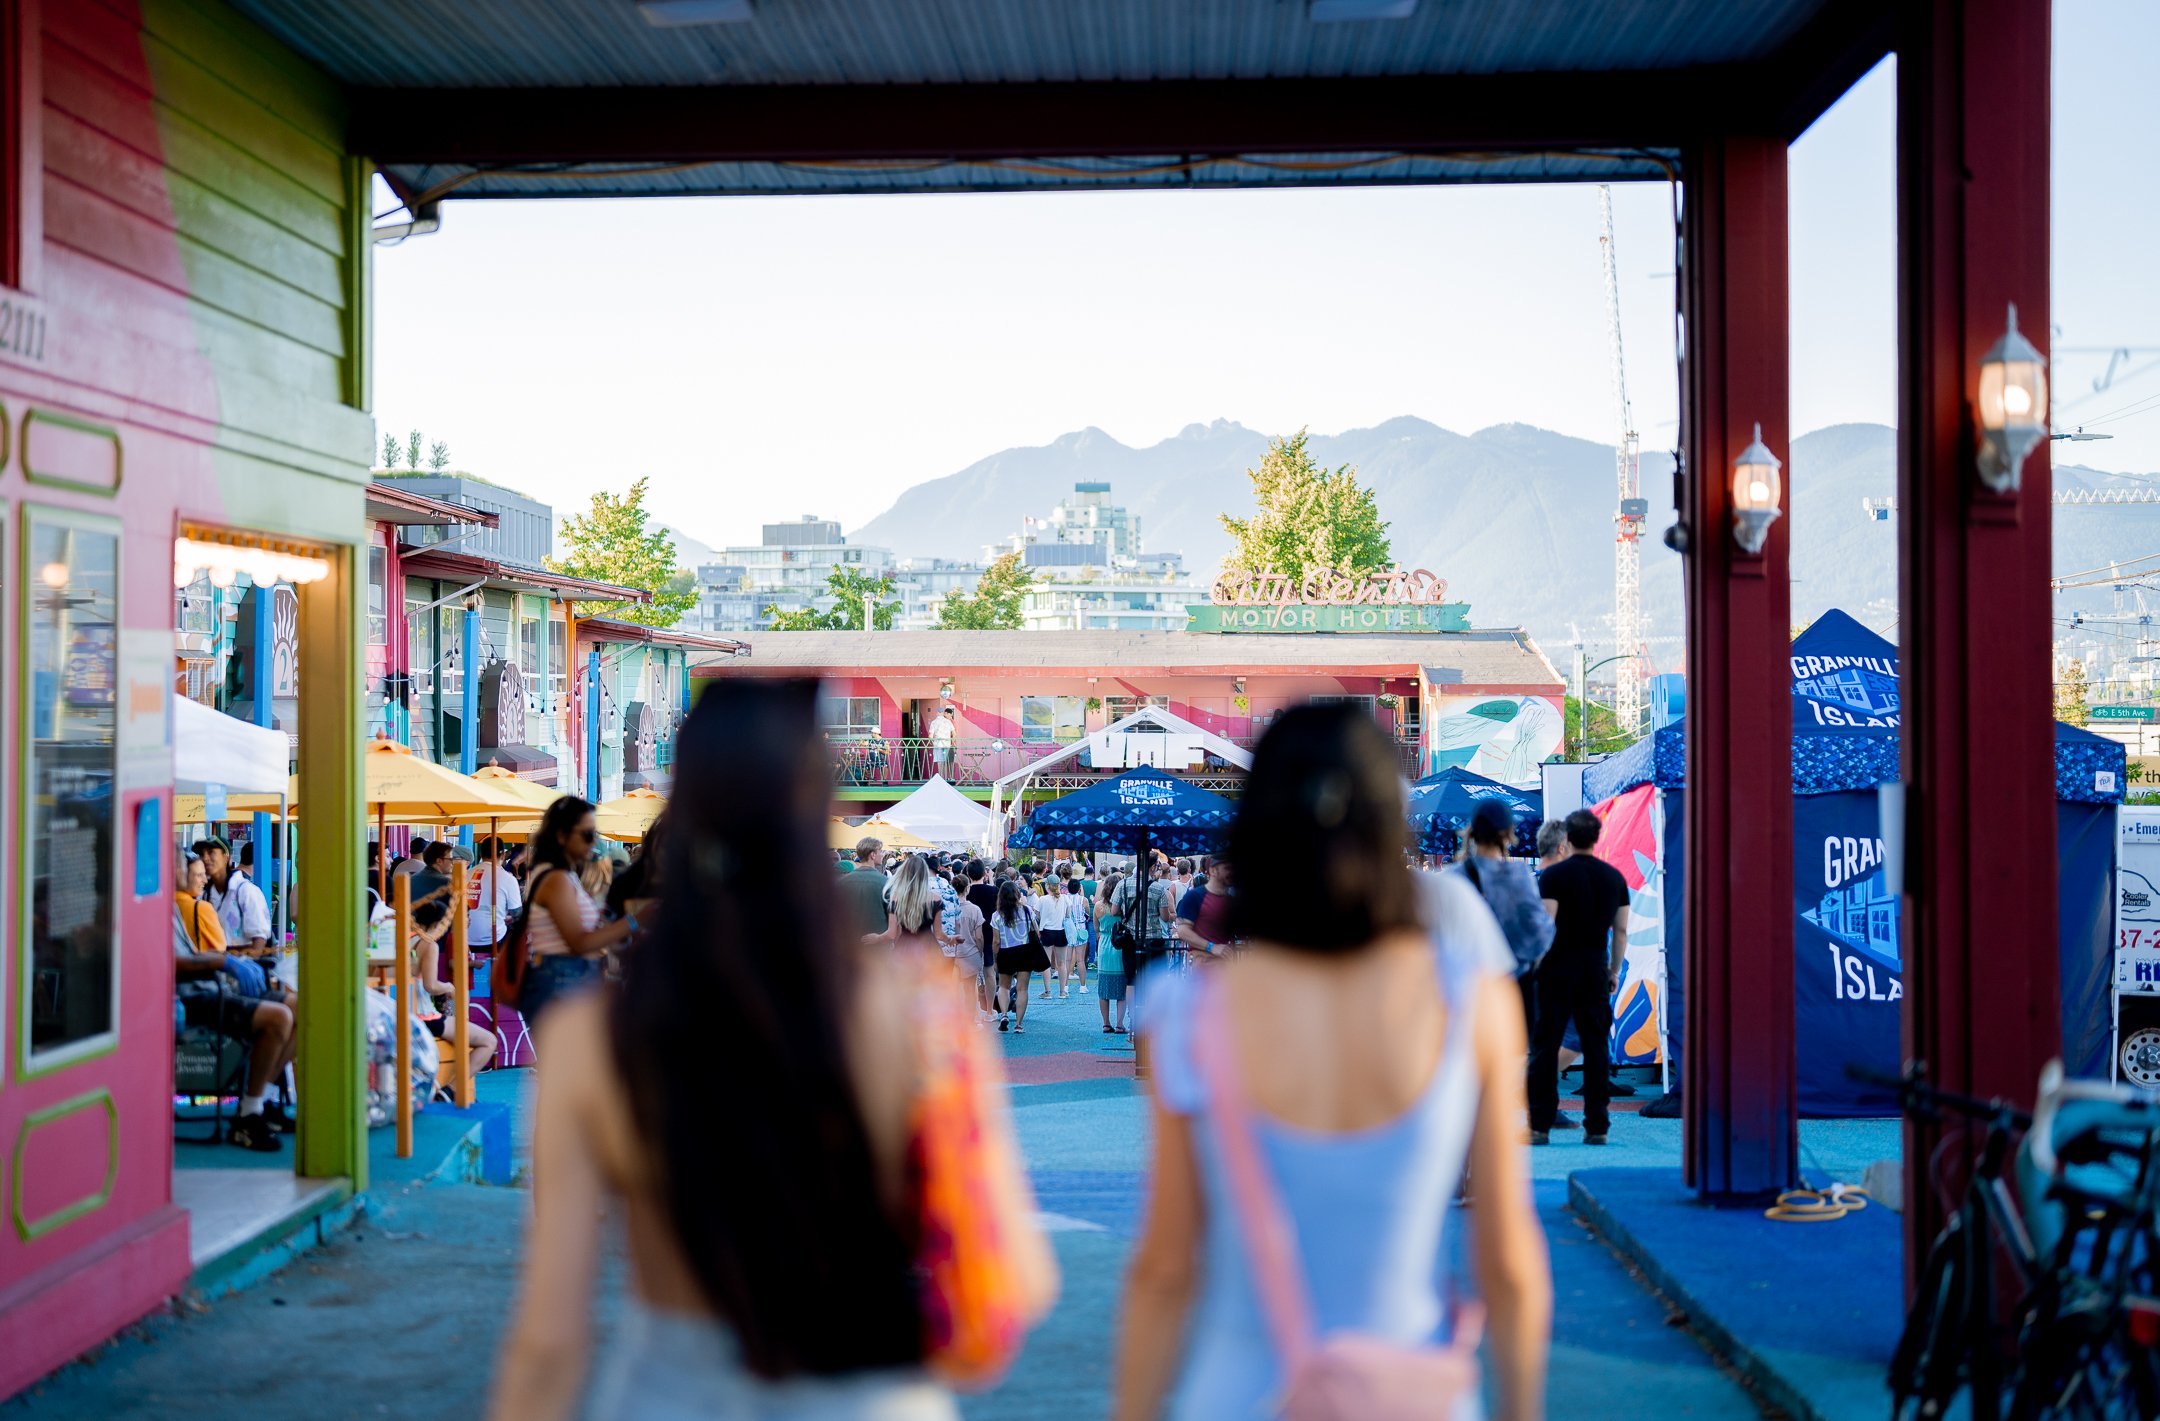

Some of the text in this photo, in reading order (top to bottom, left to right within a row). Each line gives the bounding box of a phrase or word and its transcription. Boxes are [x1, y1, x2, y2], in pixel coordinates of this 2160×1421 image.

[1209, 562, 1448, 628] City Centre
[1221, 609, 1428, 627] MOTOR HOTEL
[1790, 656, 1899, 679] GRANVILL
[2112, 708, 2147, 717] E 5th Ave.
[1120, 779, 1173, 790] GRANVILLE
[2124, 892, 2149, 900] Cooler
[2124, 899, 2151, 907] Rentals
